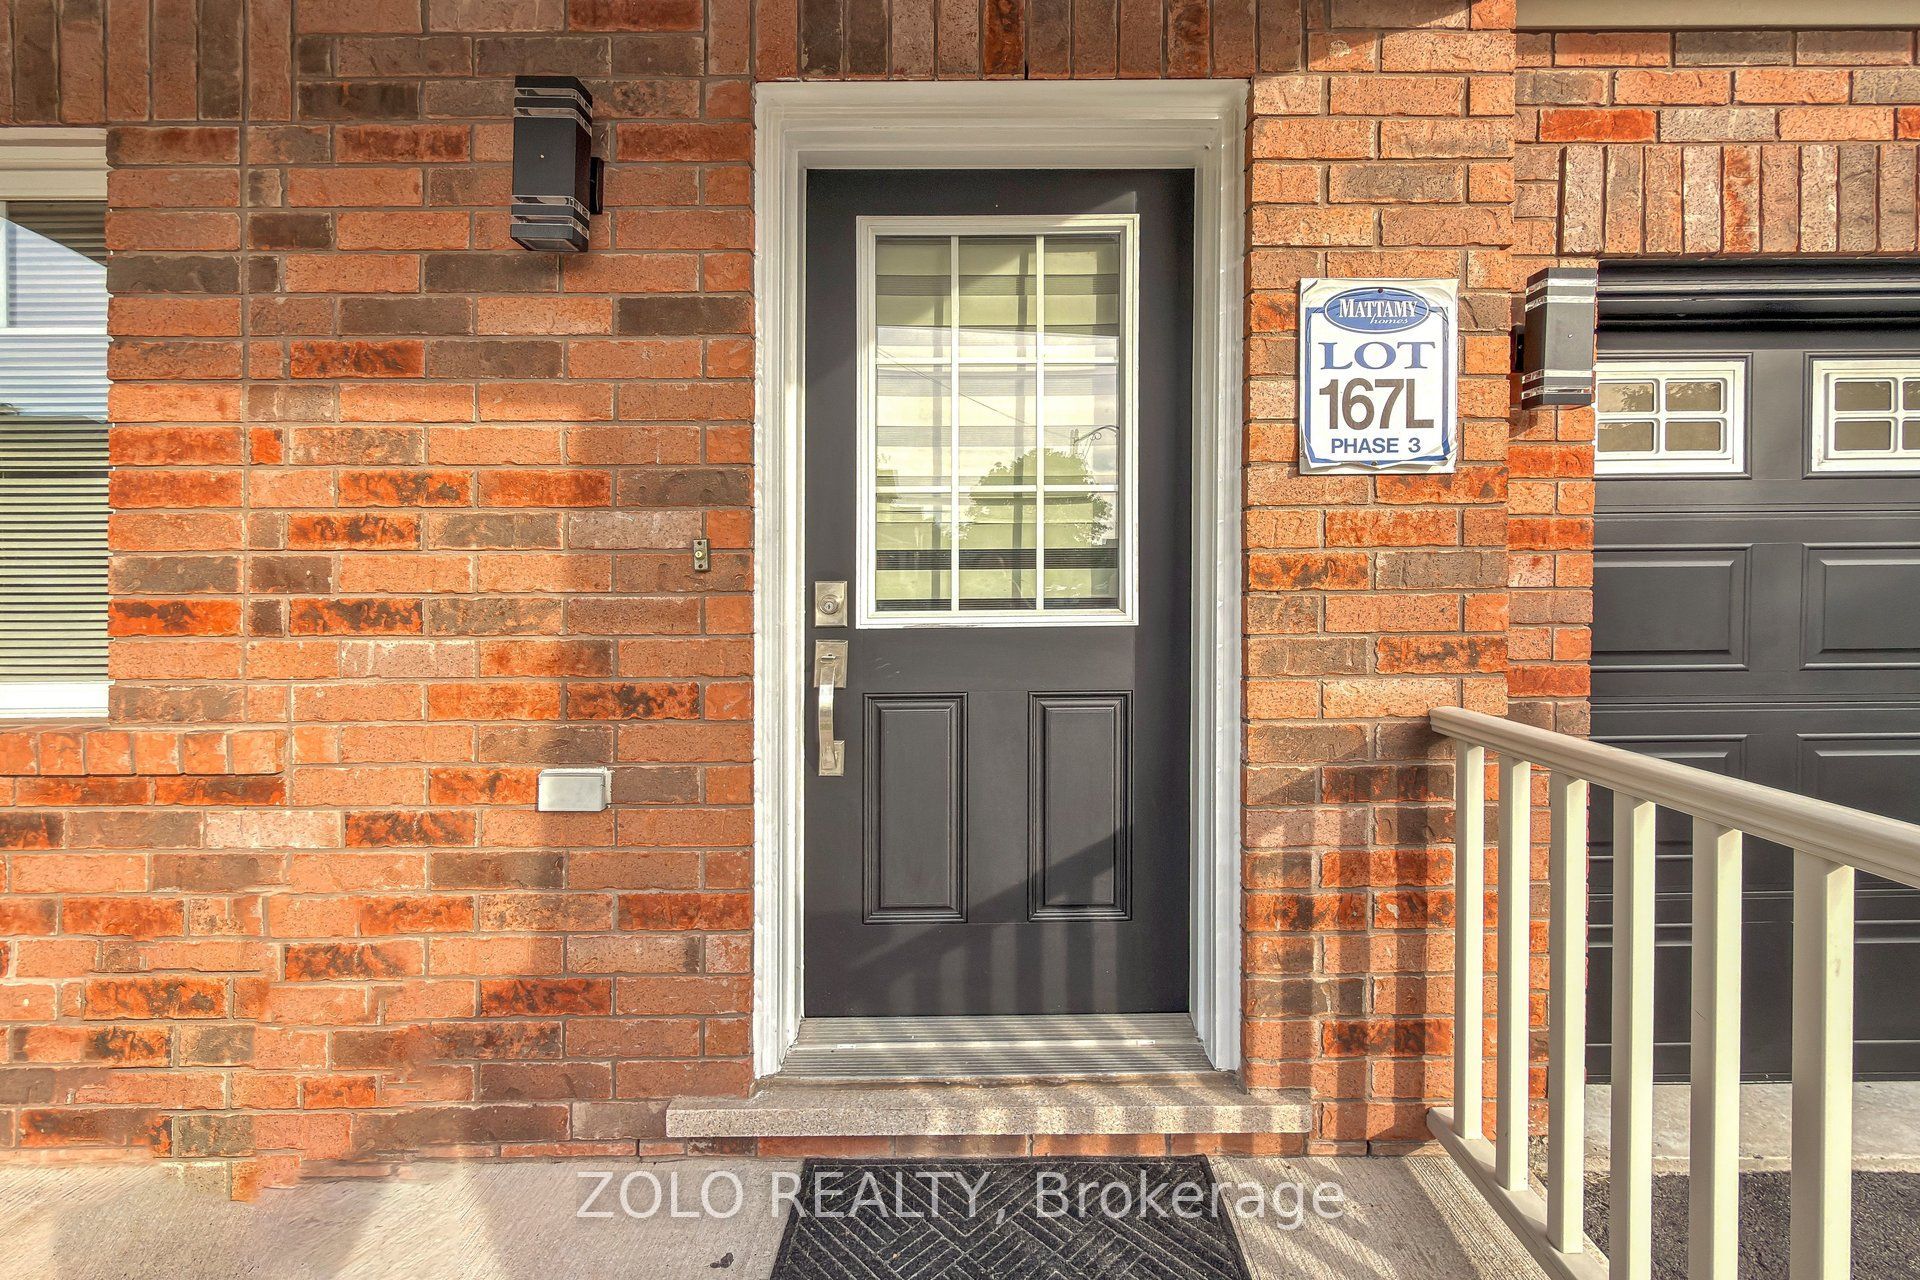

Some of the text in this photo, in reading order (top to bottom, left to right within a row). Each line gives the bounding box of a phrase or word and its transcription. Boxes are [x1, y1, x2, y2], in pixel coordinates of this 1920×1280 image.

[1338, 299, 1418, 318] MATTAMY
[1370, 314, 1409, 325] homes
[1317, 341, 1436, 370] LOT
[1319, 377, 1435, 431] 167L
[1331, 437, 1421, 454] PHASE 3
